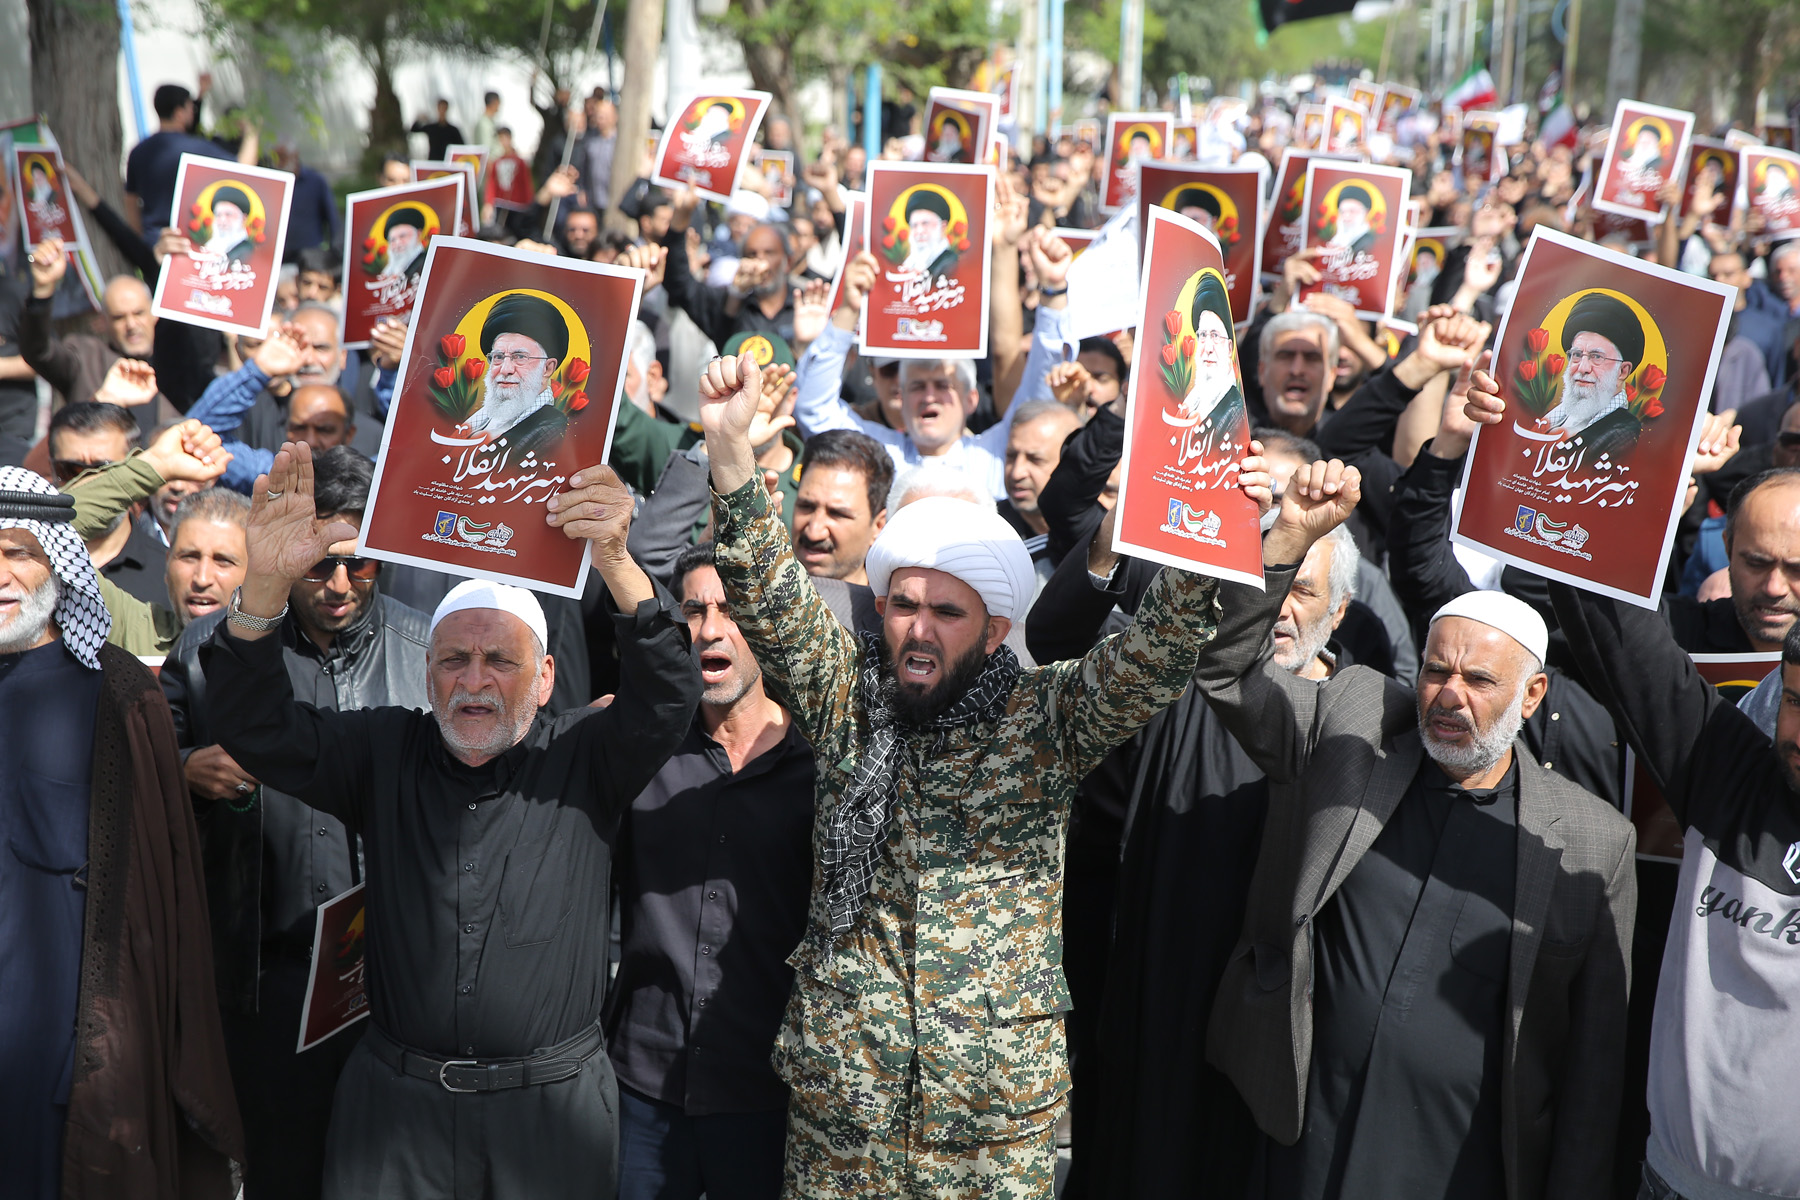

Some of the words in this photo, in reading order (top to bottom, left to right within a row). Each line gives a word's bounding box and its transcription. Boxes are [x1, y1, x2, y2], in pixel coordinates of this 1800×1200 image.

[431, 428, 512, 483] انقلاب
[1161, 407, 1215, 467] انقلاب
[1188, 432, 1232, 491] شهید
[1513, 419, 1588, 478] انقلاب
[468, 451, 538, 504] شهید
[1546, 452, 1612, 504] شهید
[1578, 478, 1640, 508] رهبر
